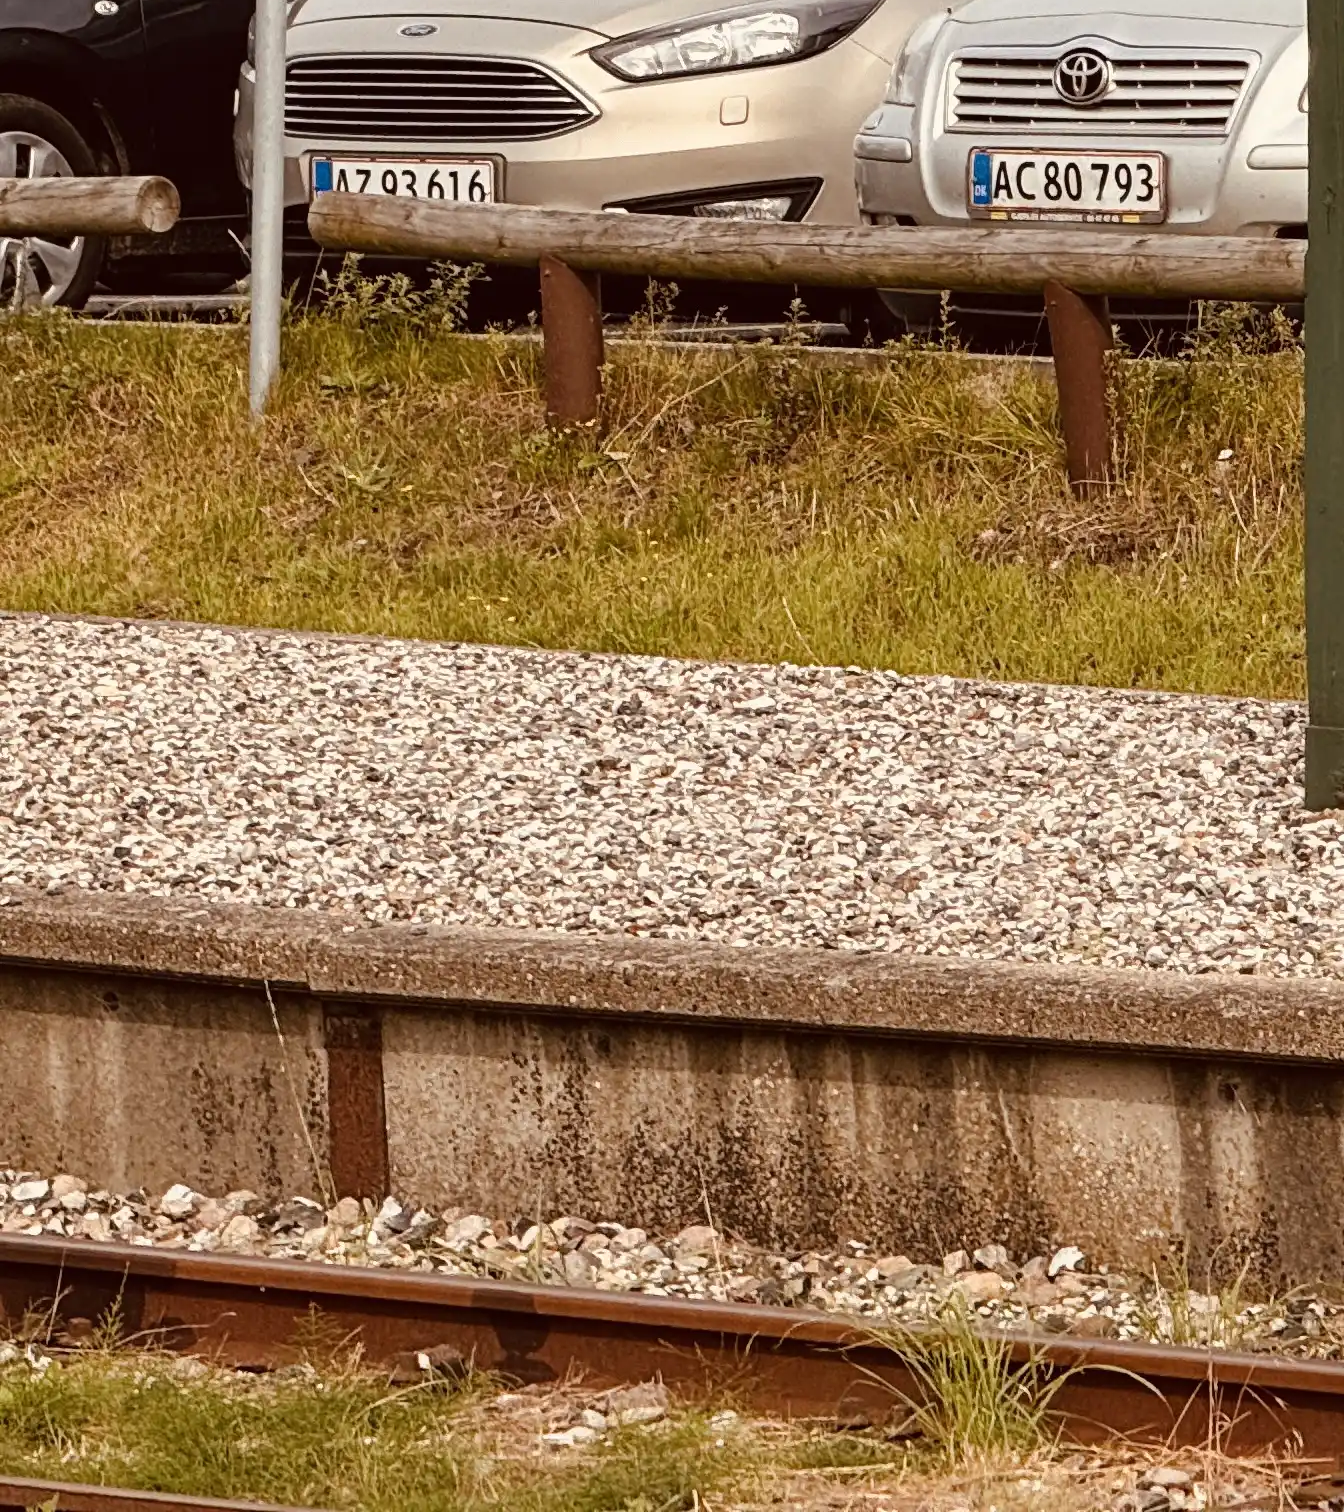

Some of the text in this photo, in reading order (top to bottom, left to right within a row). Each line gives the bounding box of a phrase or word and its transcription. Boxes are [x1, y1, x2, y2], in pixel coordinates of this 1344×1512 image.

[993, 161, 1036, 201] AC
[1044, 161, 1083, 201] 80
[1090, 163, 1154, 203] 793
